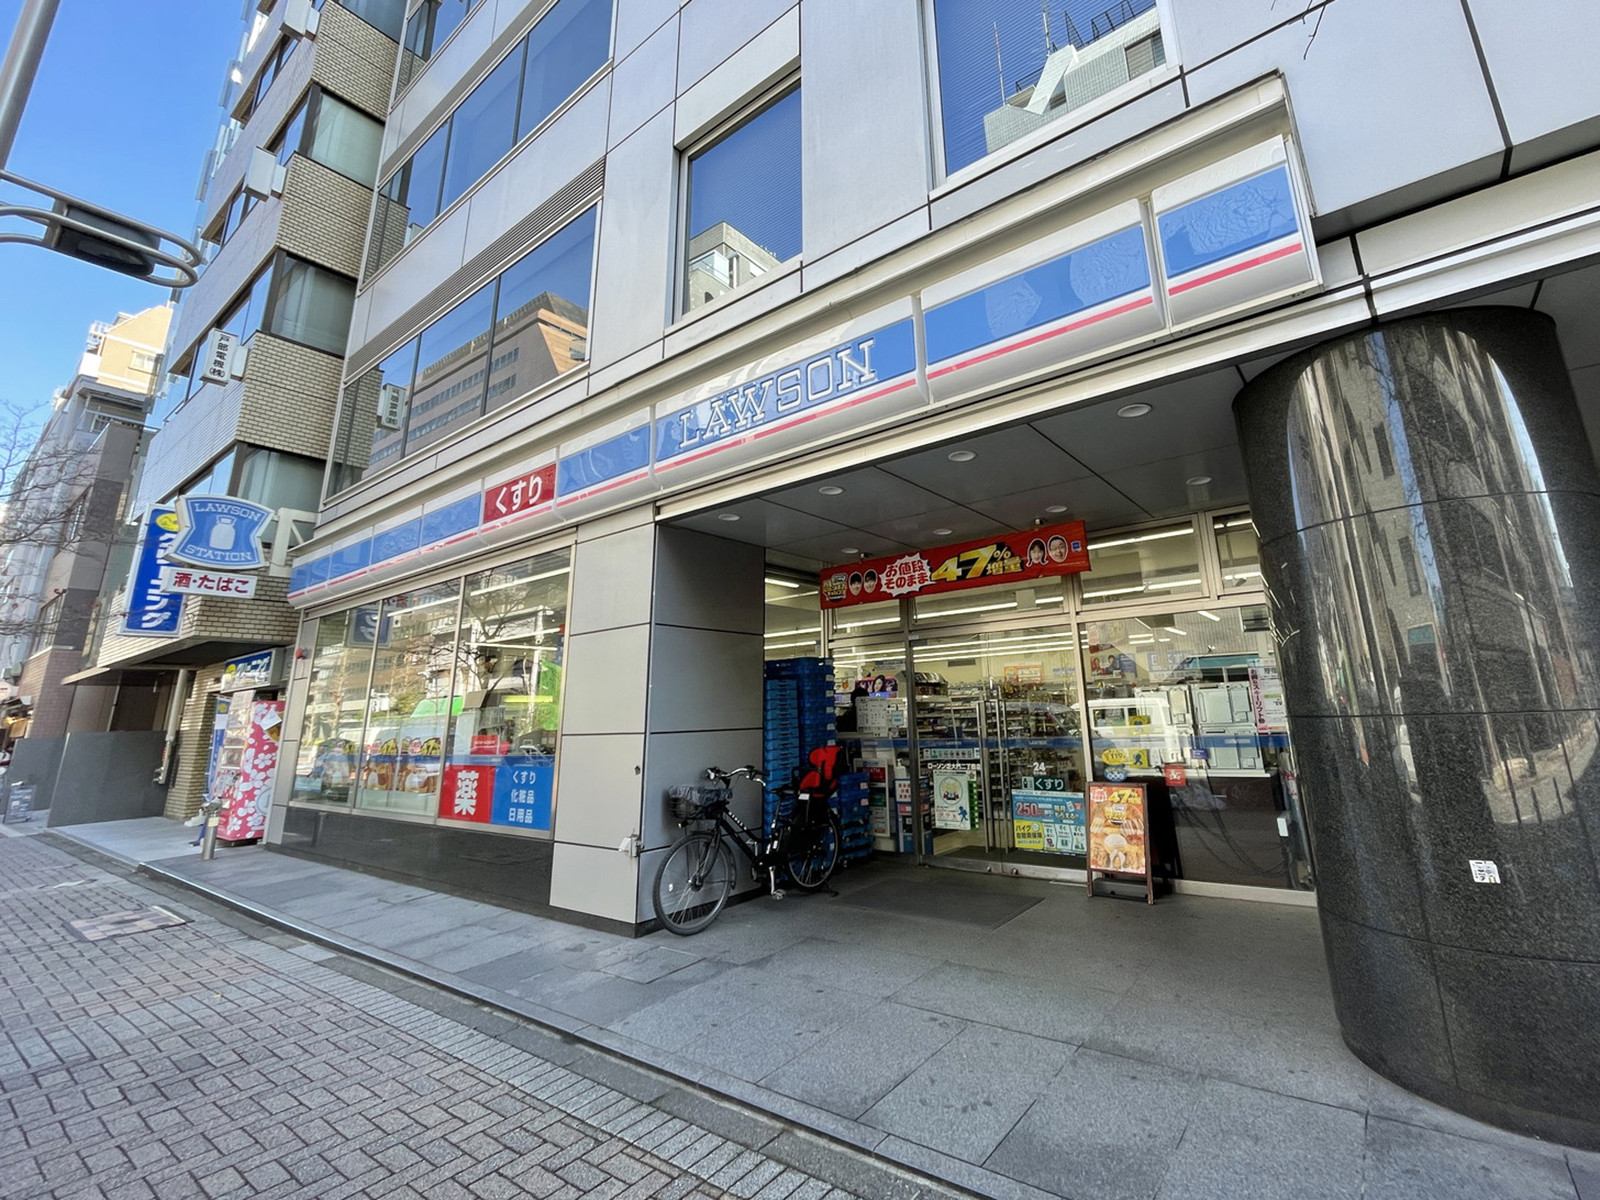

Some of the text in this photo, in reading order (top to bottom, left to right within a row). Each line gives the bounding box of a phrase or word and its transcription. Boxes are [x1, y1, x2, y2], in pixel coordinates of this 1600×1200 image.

[678, 337, 877, 450] LAWSON
[495, 475, 542, 515] くすり
[195, 503, 263, 521] LAWSON
[185, 544, 252, 561] STATION
[885, 559, 925, 578] お値段
[173, 572, 250, 594] 酒・たばこ
[884, 573, 929, 590] そのまま
[1033, 761, 1046, 771] 24
[512, 770, 537, 784] くすり
[1035, 778, 1064, 791] くすり
[454, 770, 480, 816] 薬
[510, 789, 535, 805] 化粧品
[508, 808, 533, 824] 日用品
